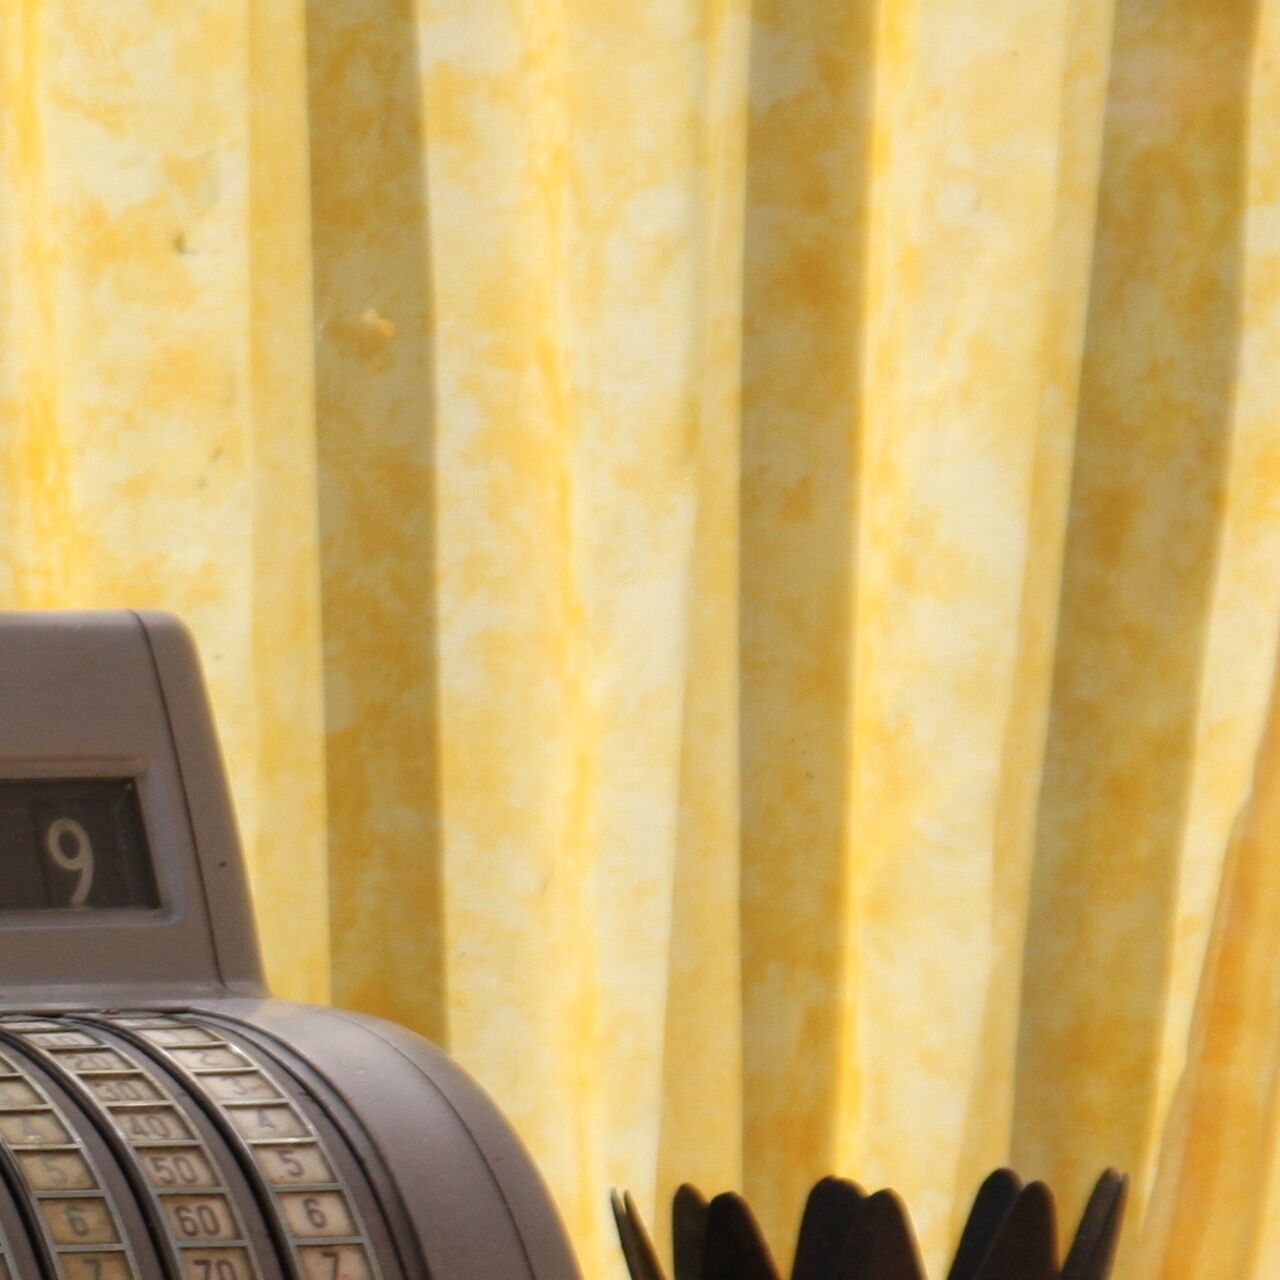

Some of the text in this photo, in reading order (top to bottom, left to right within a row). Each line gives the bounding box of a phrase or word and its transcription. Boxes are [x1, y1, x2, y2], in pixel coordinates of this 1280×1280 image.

[131, 1115, 172, 1139] 40
[41, 1155, 69, 1185] 5
[149, 1156, 198, 1185] 50
[277, 1150, 305, 1178] 5
[65, 1203, 89, 1236] 6
[174, 1203, 220, 1237] 60
[303, 1197, 327, 1229] 6
